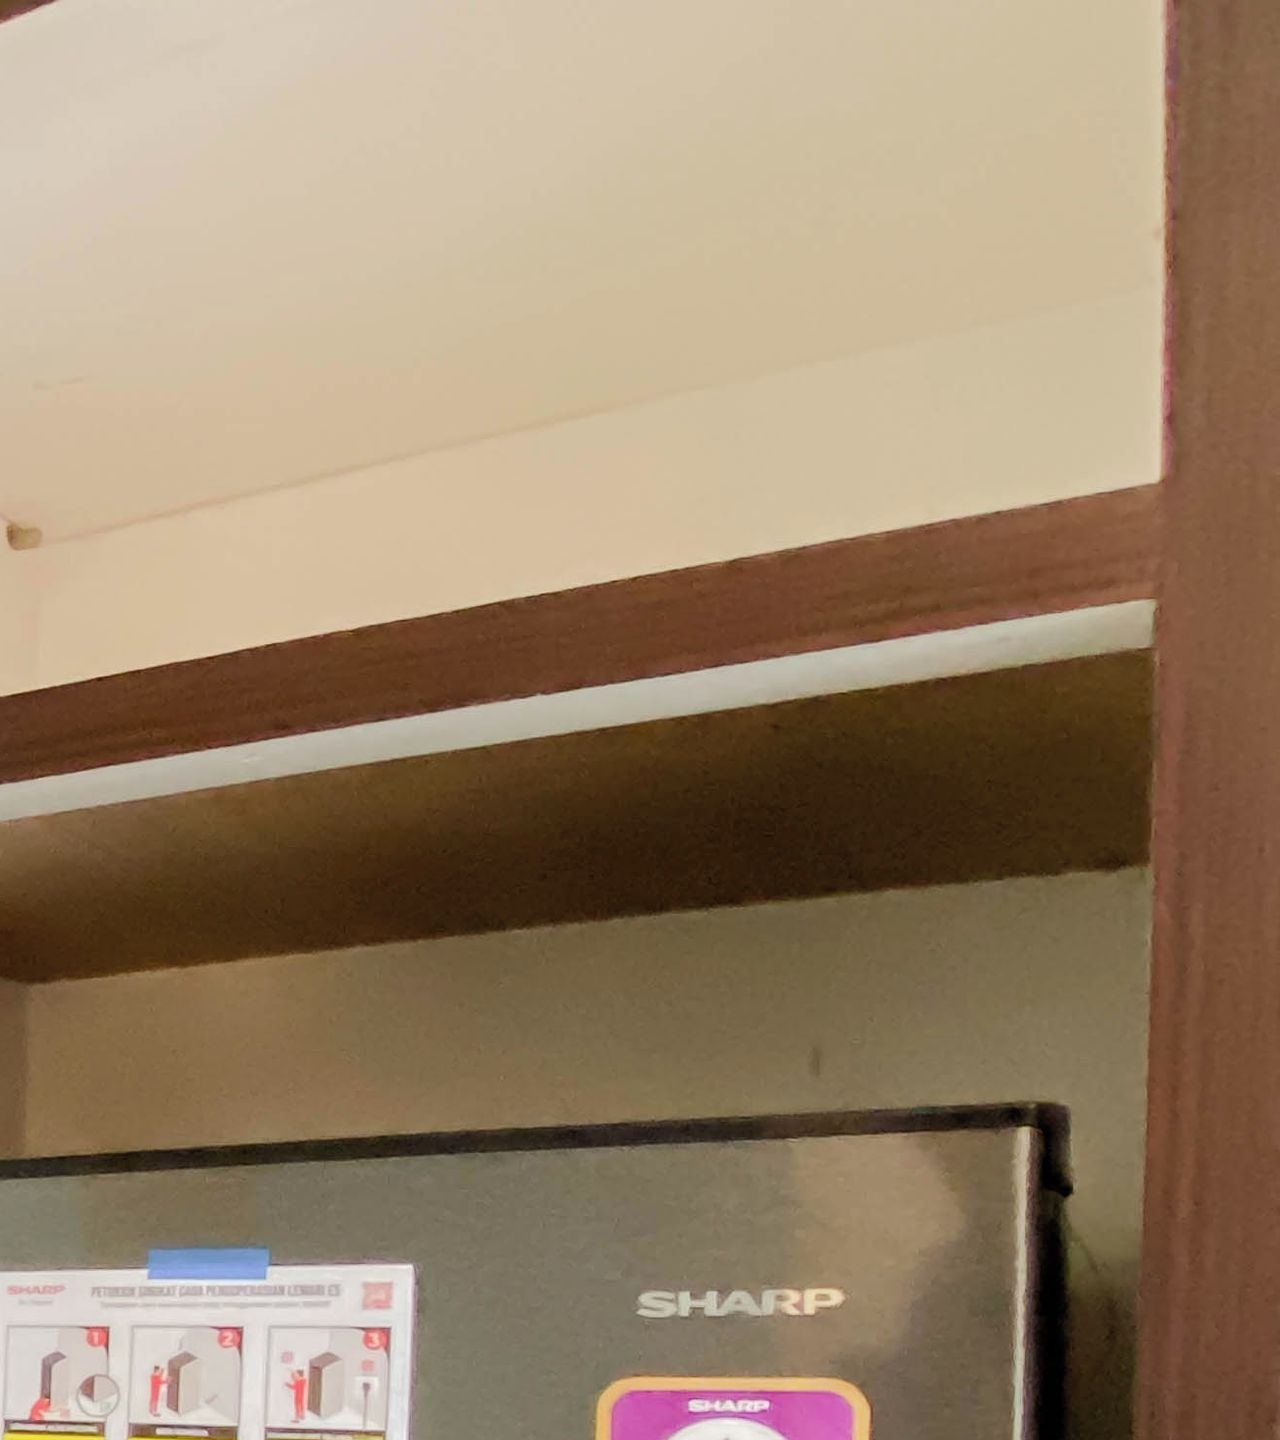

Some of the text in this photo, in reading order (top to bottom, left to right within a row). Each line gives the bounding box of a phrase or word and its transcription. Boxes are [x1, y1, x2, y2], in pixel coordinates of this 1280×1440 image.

[7, 1284, 66, 1295] SHARP
[637, 1287, 846, 1319] SHARP
[687, 1398, 771, 1414] SHARP
